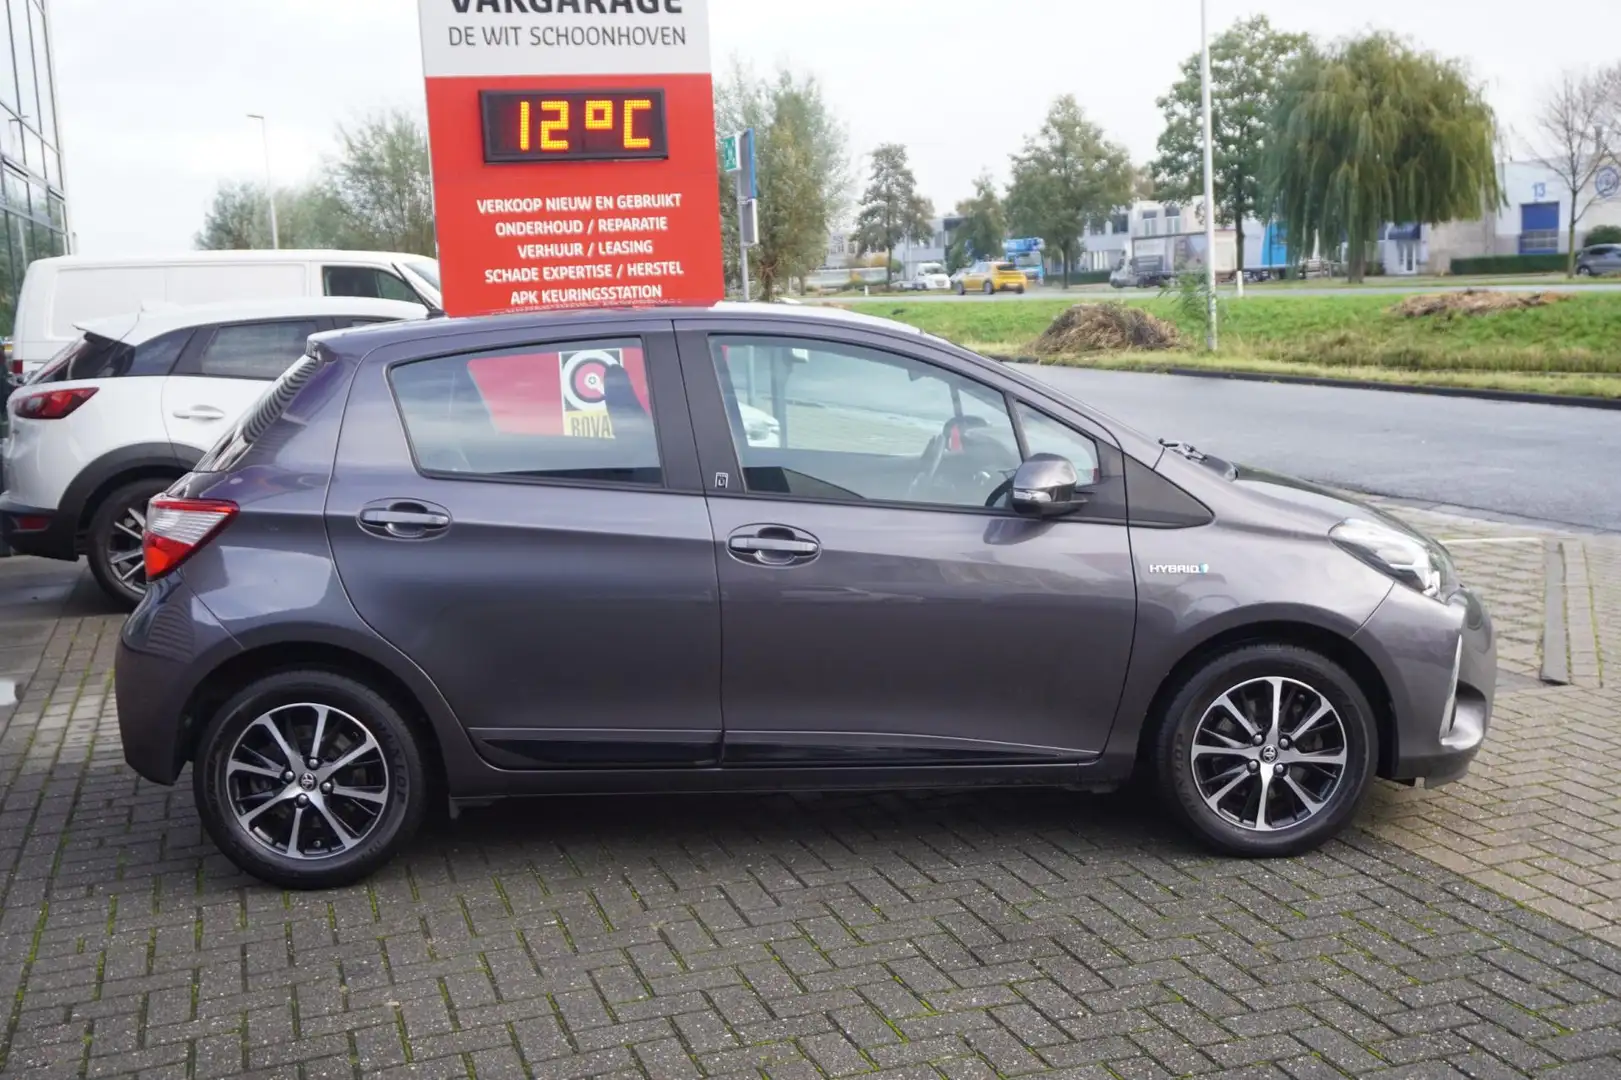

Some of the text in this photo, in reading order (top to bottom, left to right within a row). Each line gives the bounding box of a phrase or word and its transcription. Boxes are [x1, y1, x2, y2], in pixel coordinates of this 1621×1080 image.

[448, 26, 686, 46] DE WIT SCHOONHOVEN
[476, 193, 682, 214] VERKOOP NIEUW EN GEBRUIKT
[495, 220, 584, 236] ONDERHOUD
[598, 216, 668, 232] REPARATIE
[517, 243, 584, 259] VERHUUR
[598, 240, 653, 256] LEASING
[484, 267, 539, 284] SCHADE
[542, 264, 612, 281] EXPERTISE
[627, 261, 684, 277] HERSTEL
[510, 284, 663, 305] APK KEURINGSSTATION
[1149, 564, 1200, 574] HYBRID
